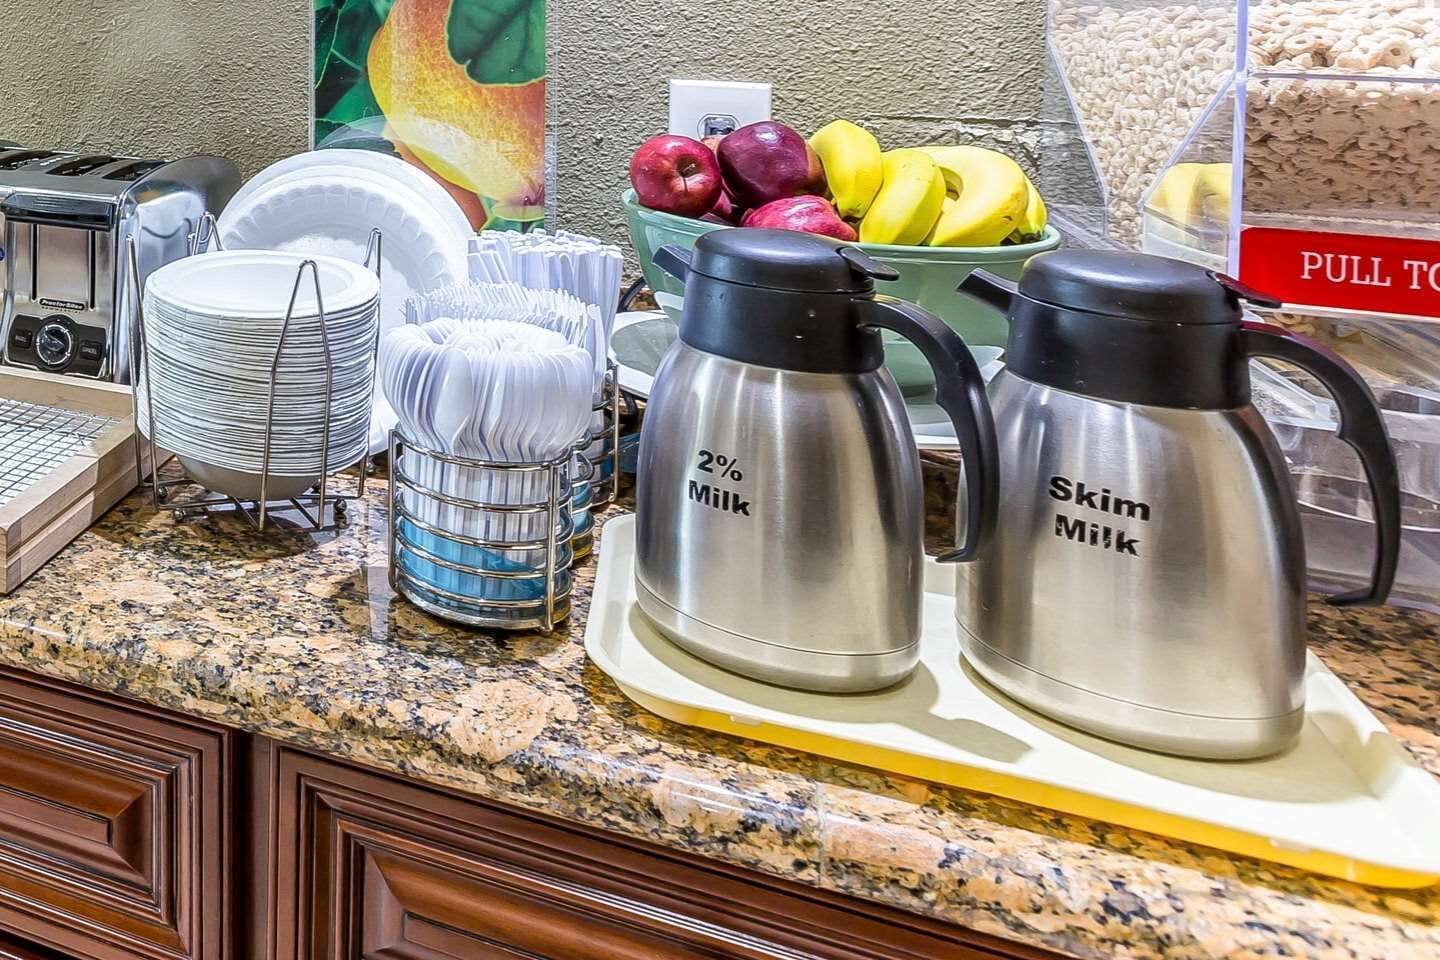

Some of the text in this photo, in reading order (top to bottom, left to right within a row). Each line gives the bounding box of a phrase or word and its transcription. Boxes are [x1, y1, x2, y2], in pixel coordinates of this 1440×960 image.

[1301, 251, 1392, 287] PULL
[697, 449, 743, 482] 2%
[688, 479, 751, 517] Milk
[1048, 476, 1151, 521] Skim
[1055, 513, 1141, 557] Milk
